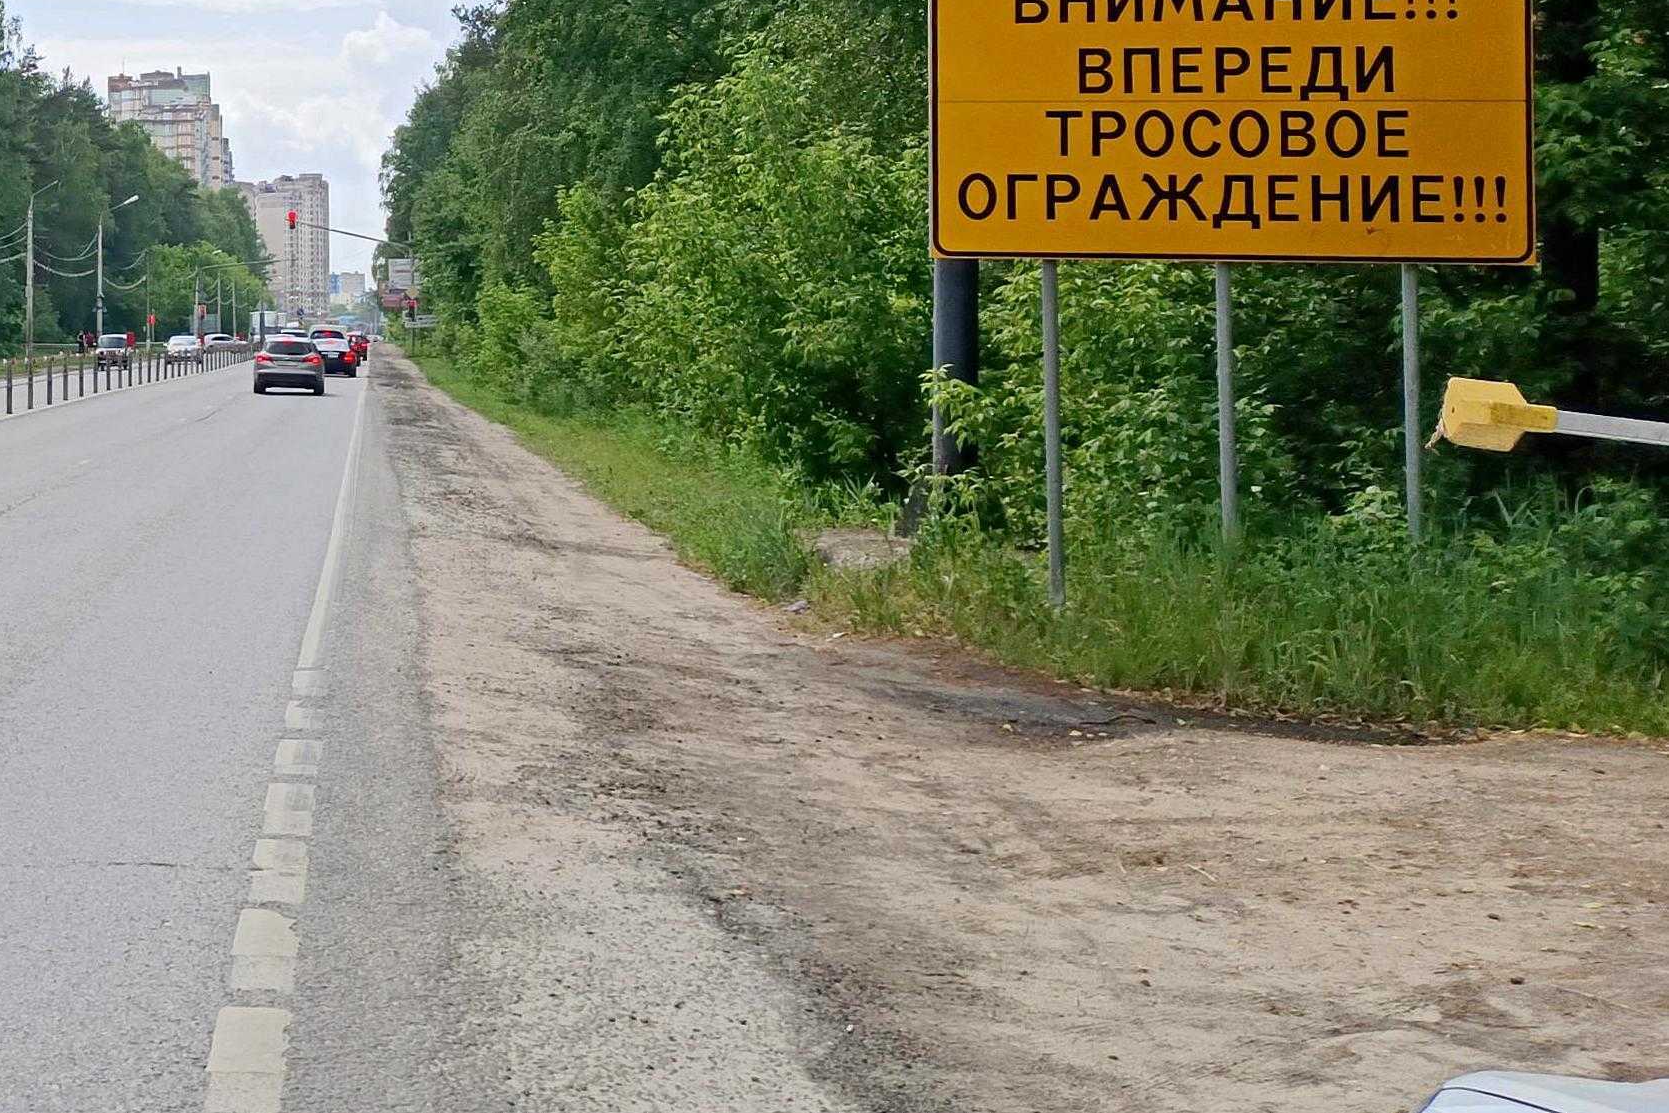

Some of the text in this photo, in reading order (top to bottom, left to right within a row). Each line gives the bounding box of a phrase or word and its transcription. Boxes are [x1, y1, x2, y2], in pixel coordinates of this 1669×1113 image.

[1078, 46, 1395, 100] ВПЕРЕДИ
[1046, 109, 1410, 158] ТРОСОВОЕ
[958, 173, 1507, 229] ОГРАЖДЕНИЕ!!!
